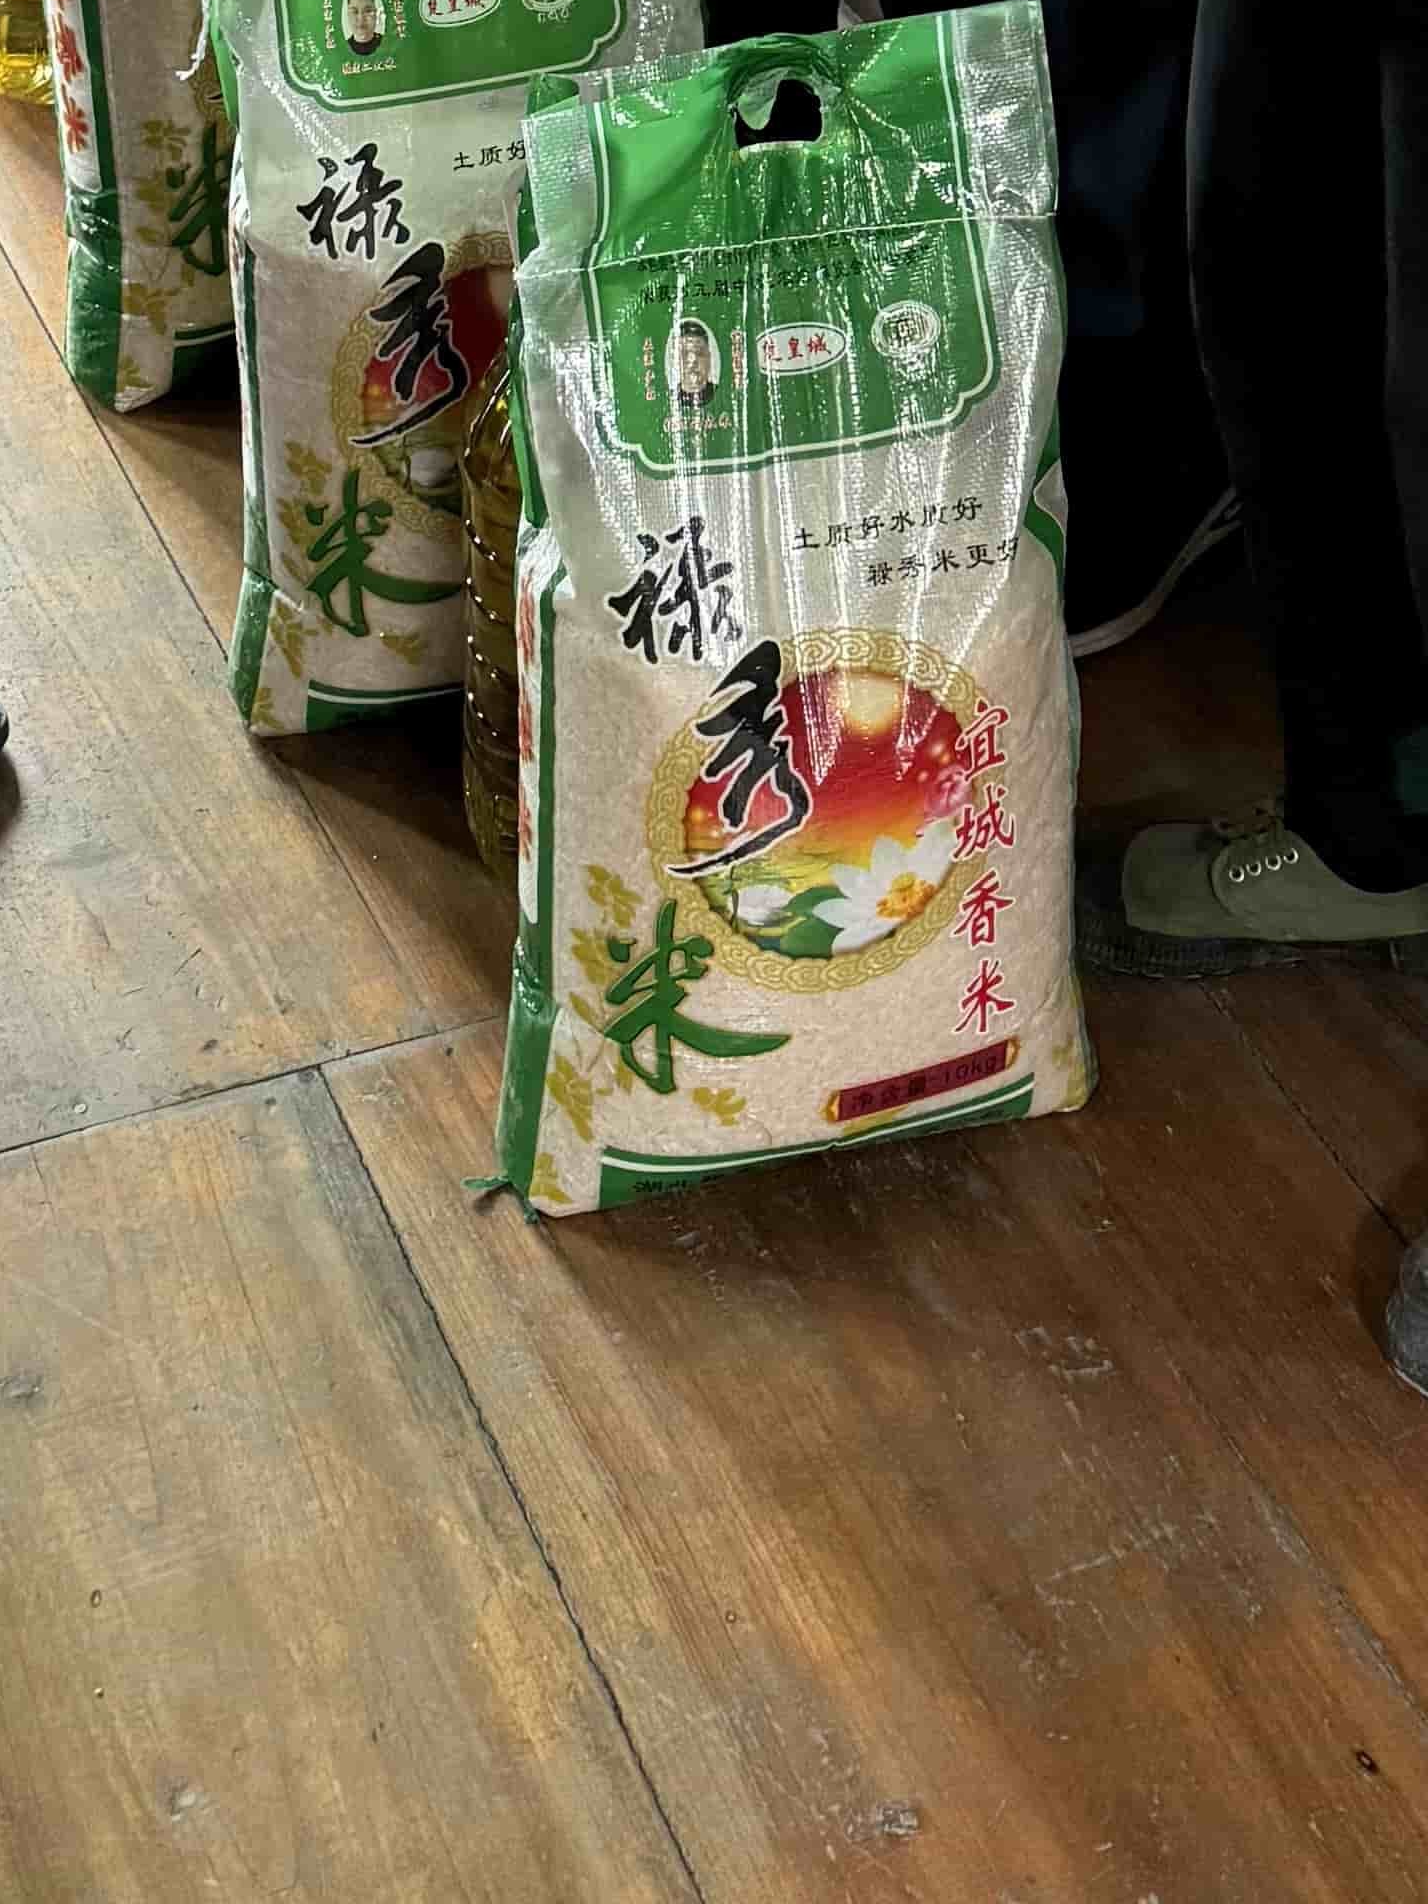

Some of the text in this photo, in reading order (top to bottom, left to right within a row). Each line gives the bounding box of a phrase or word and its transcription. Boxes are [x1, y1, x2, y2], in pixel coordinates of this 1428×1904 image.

[792, 496, 982, 550] 土质好水质好
[954, 699, 1014, 1033] 宜城香米
